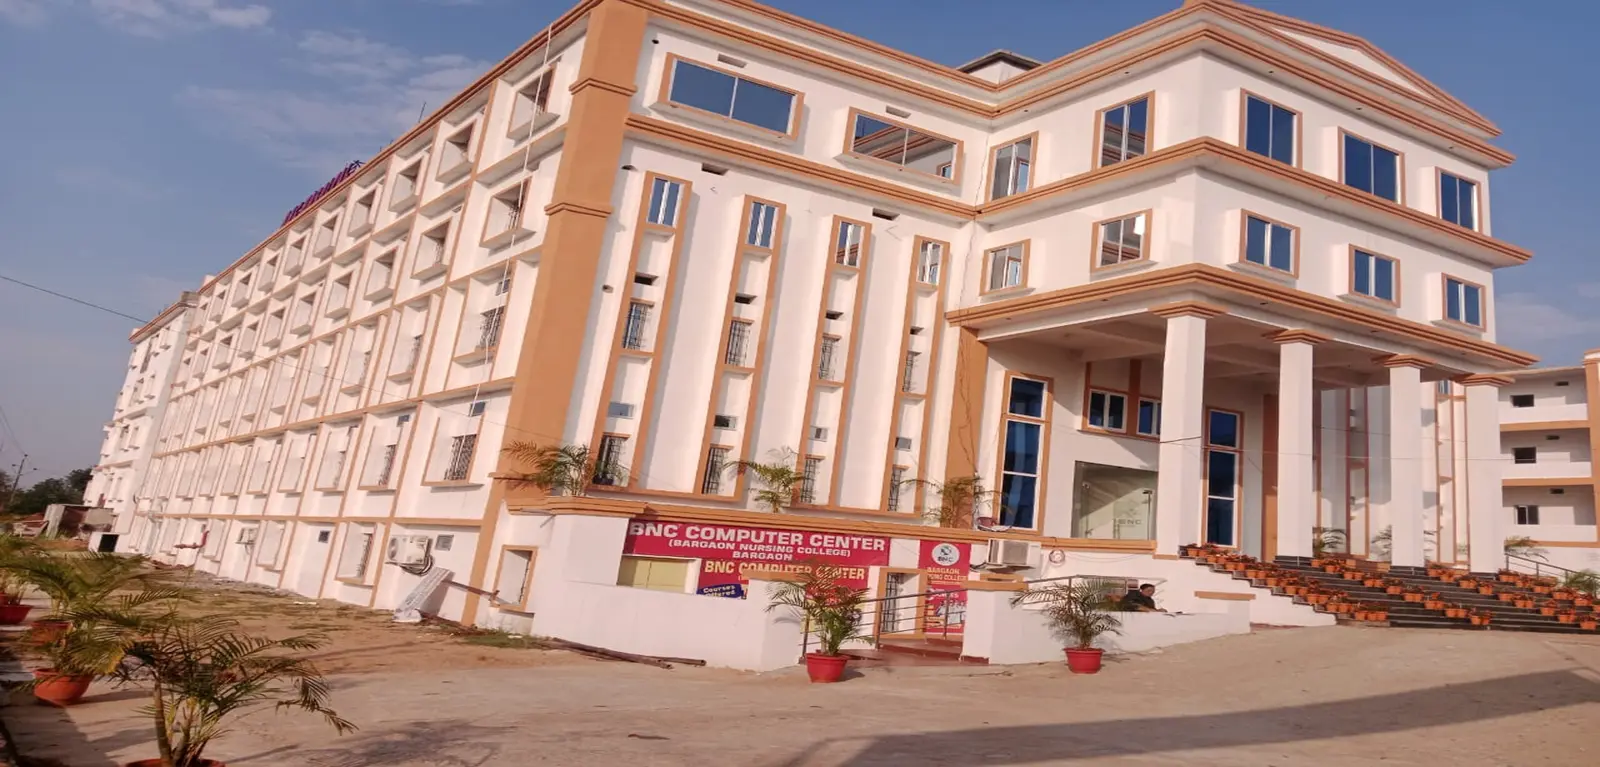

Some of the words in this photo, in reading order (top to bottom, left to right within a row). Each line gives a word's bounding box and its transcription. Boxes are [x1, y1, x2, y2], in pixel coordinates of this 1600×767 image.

[629, 522, 678, 538] BNC
[685, 525, 804, 546] COMPUTER
[809, 534, 885, 551] CENTER
[668, 539, 735, 550] (BARGAON
[739, 543, 793, 553] NURSING
[797, 546, 851, 557] COLLEGE)
[732, 551, 793, 561] BARGAON
[704, 561, 735, 574] BNC
